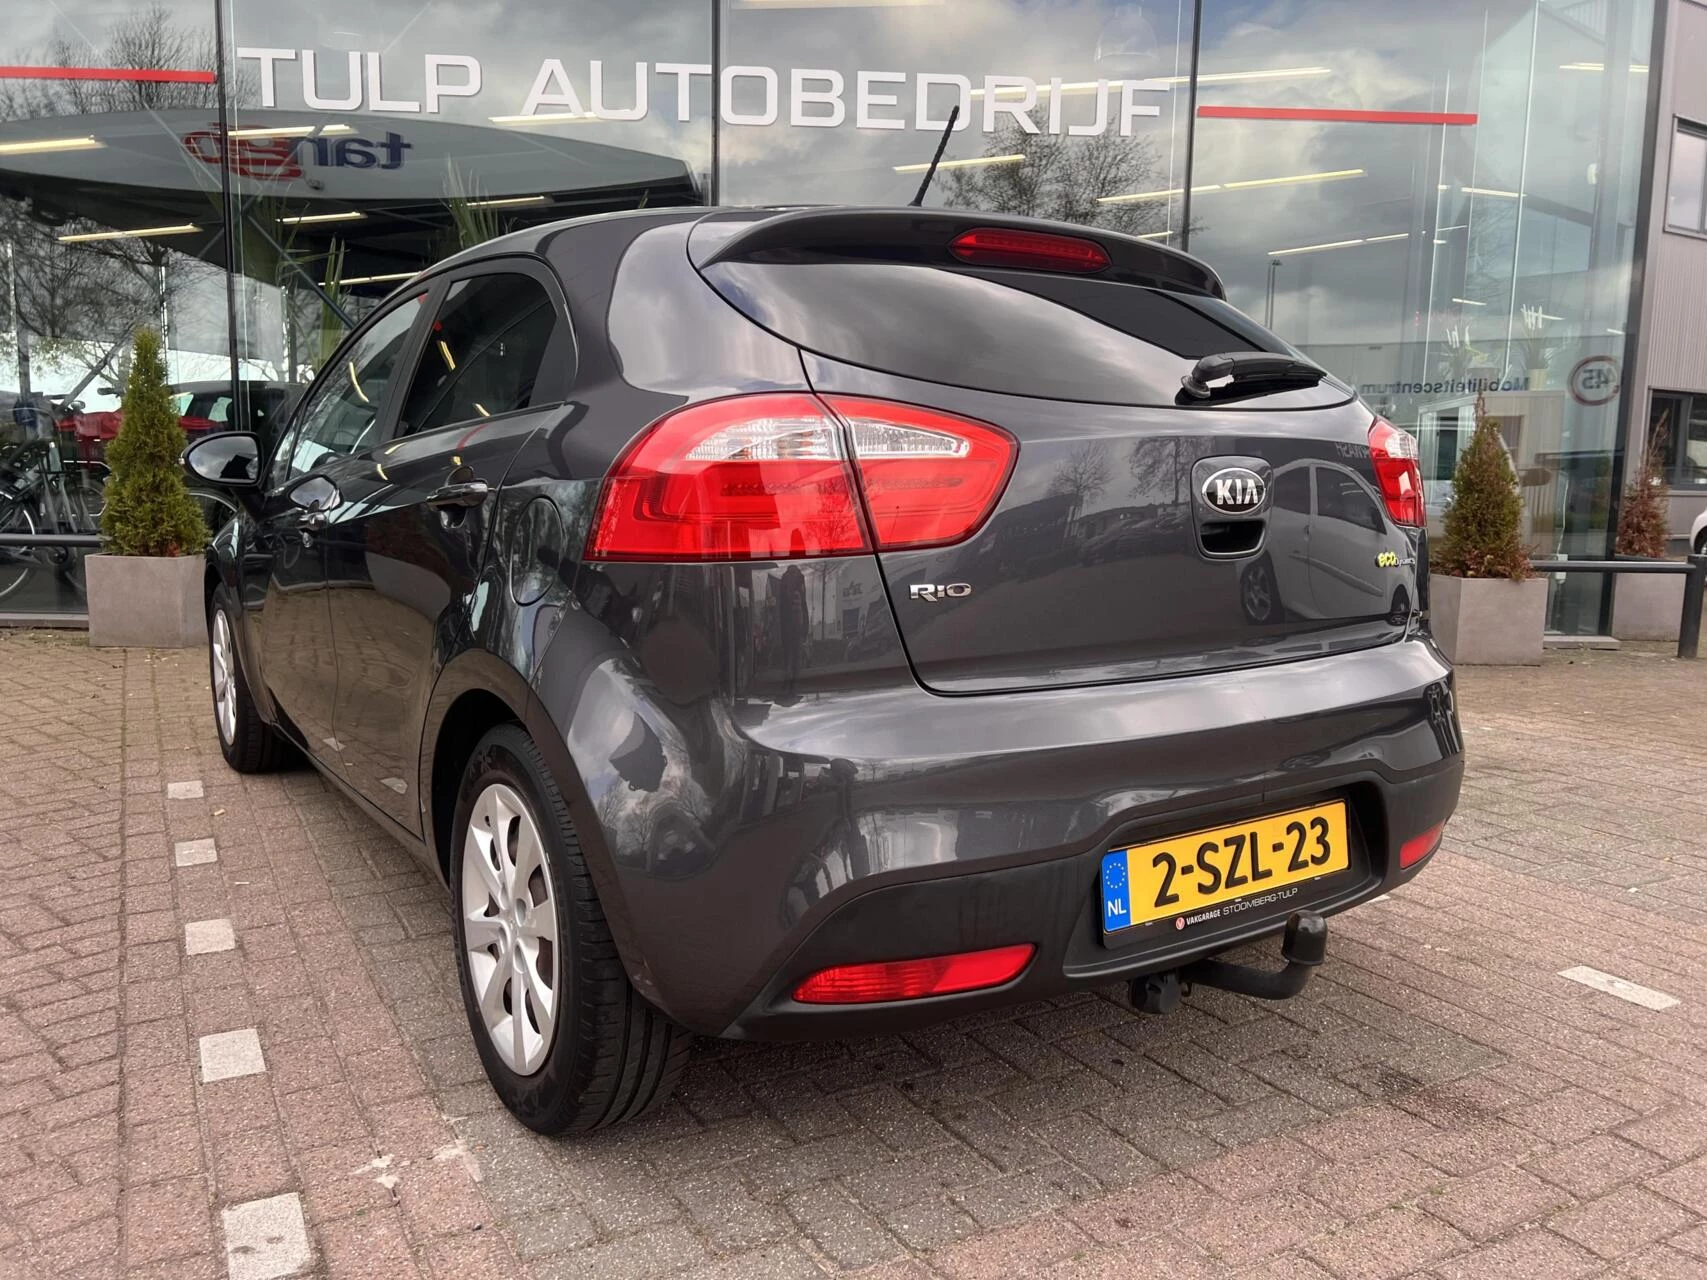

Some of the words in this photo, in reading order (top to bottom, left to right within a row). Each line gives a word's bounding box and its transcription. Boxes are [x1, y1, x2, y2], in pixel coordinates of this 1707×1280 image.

[236, 47, 482, 113] TULP
[520, 58, 1170, 138] AUTOBEDRIJF
[1216, 478, 1259, 505] KIA
[1152, 816, 1331, 908] 2-SZL-23
[1107, 898, 1127, 917] NL
[1186, 909, 1221, 926] VAKGARAGE
[1223, 887, 1298, 916] STOOMBERG-TULP
